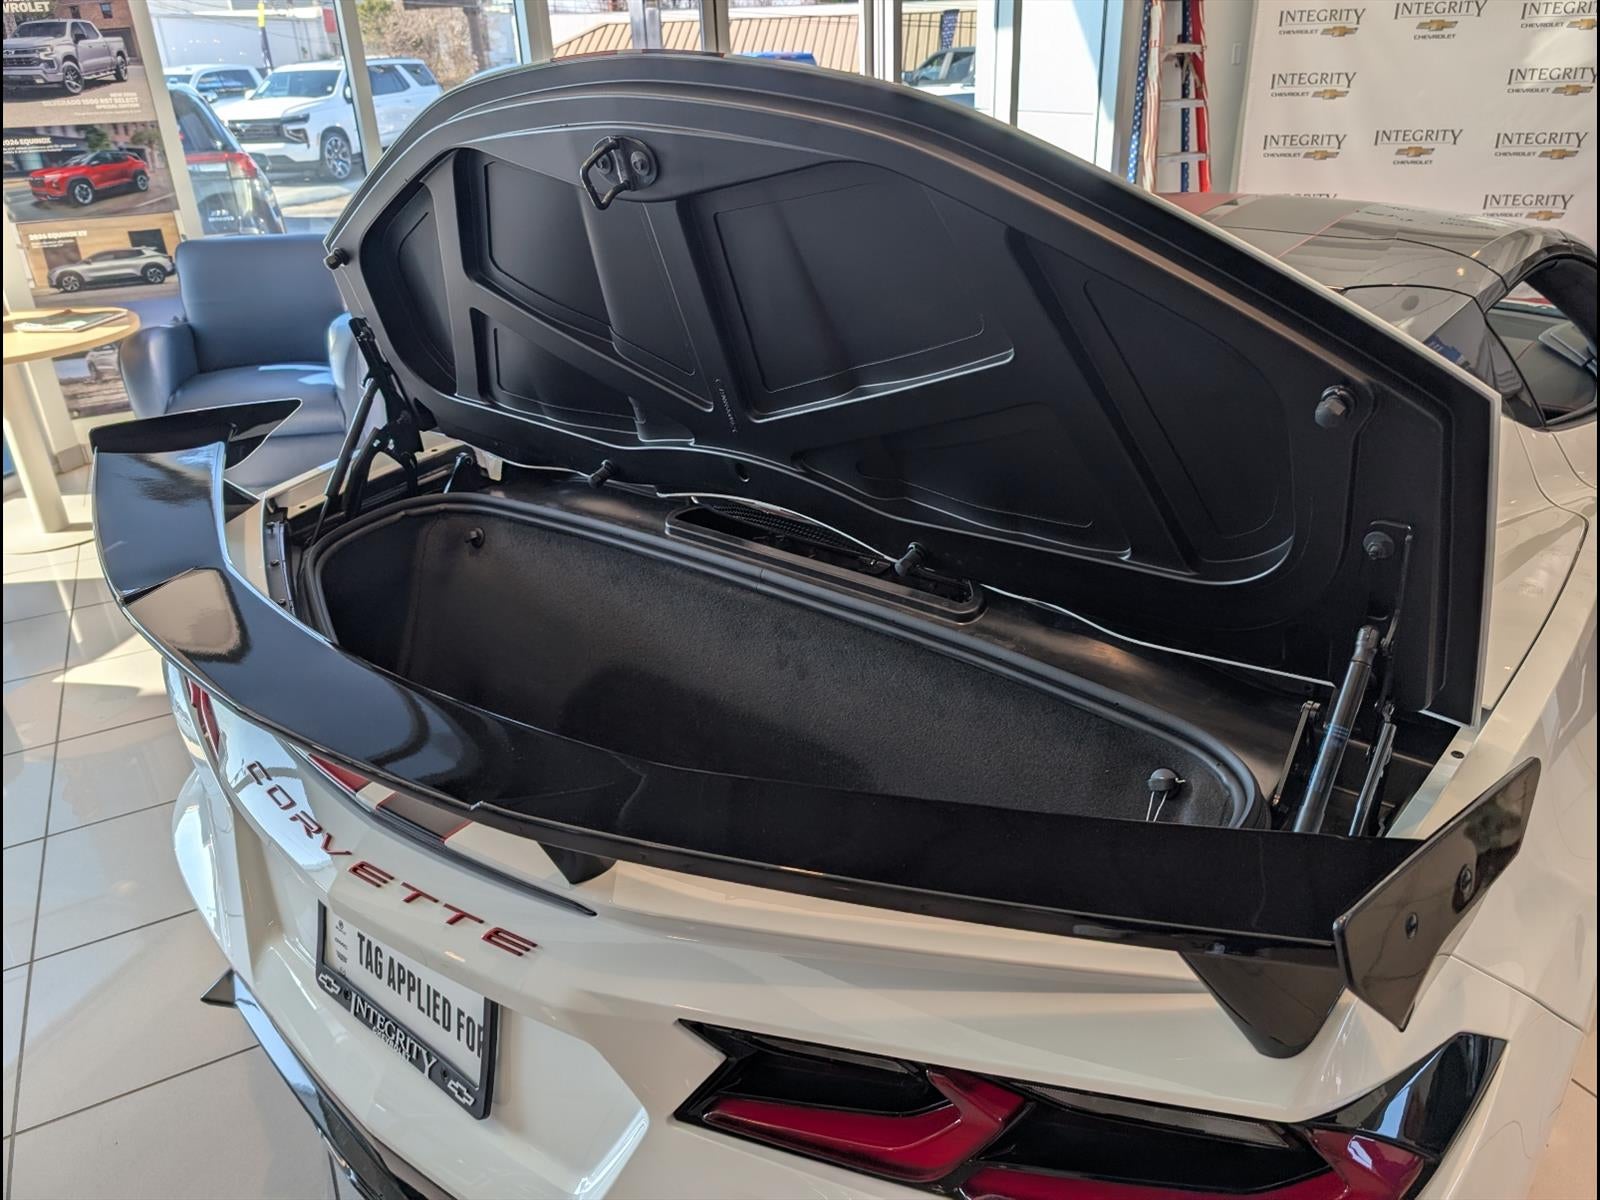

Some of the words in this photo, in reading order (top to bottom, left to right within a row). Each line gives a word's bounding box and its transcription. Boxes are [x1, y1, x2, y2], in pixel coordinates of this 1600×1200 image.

[1279, 8, 1366, 27] INTEGRITY
[1393, 0, 1487, 19] INTEGRITY
[1521, 1, 1597, 19] INTEGRI
[1271, 72, 1357, 89] INTEGRITY
[1507, 67, 1597, 85] INTEGRITY
[1263, 134, 1348, 150] INTEGRITY
[1374, 129, 1463, 146] INTEGRITY
[1495, 132, 1589, 149] INTEGRITY
[1482, 194, 1574, 210] INTEGRITY
[246, 760, 538, 957] CORVETTE
[357, 931, 383, 980] TAG
[387, 956, 451, 1033] APPLIED
[350, 991, 438, 1079] INTEGRITY
